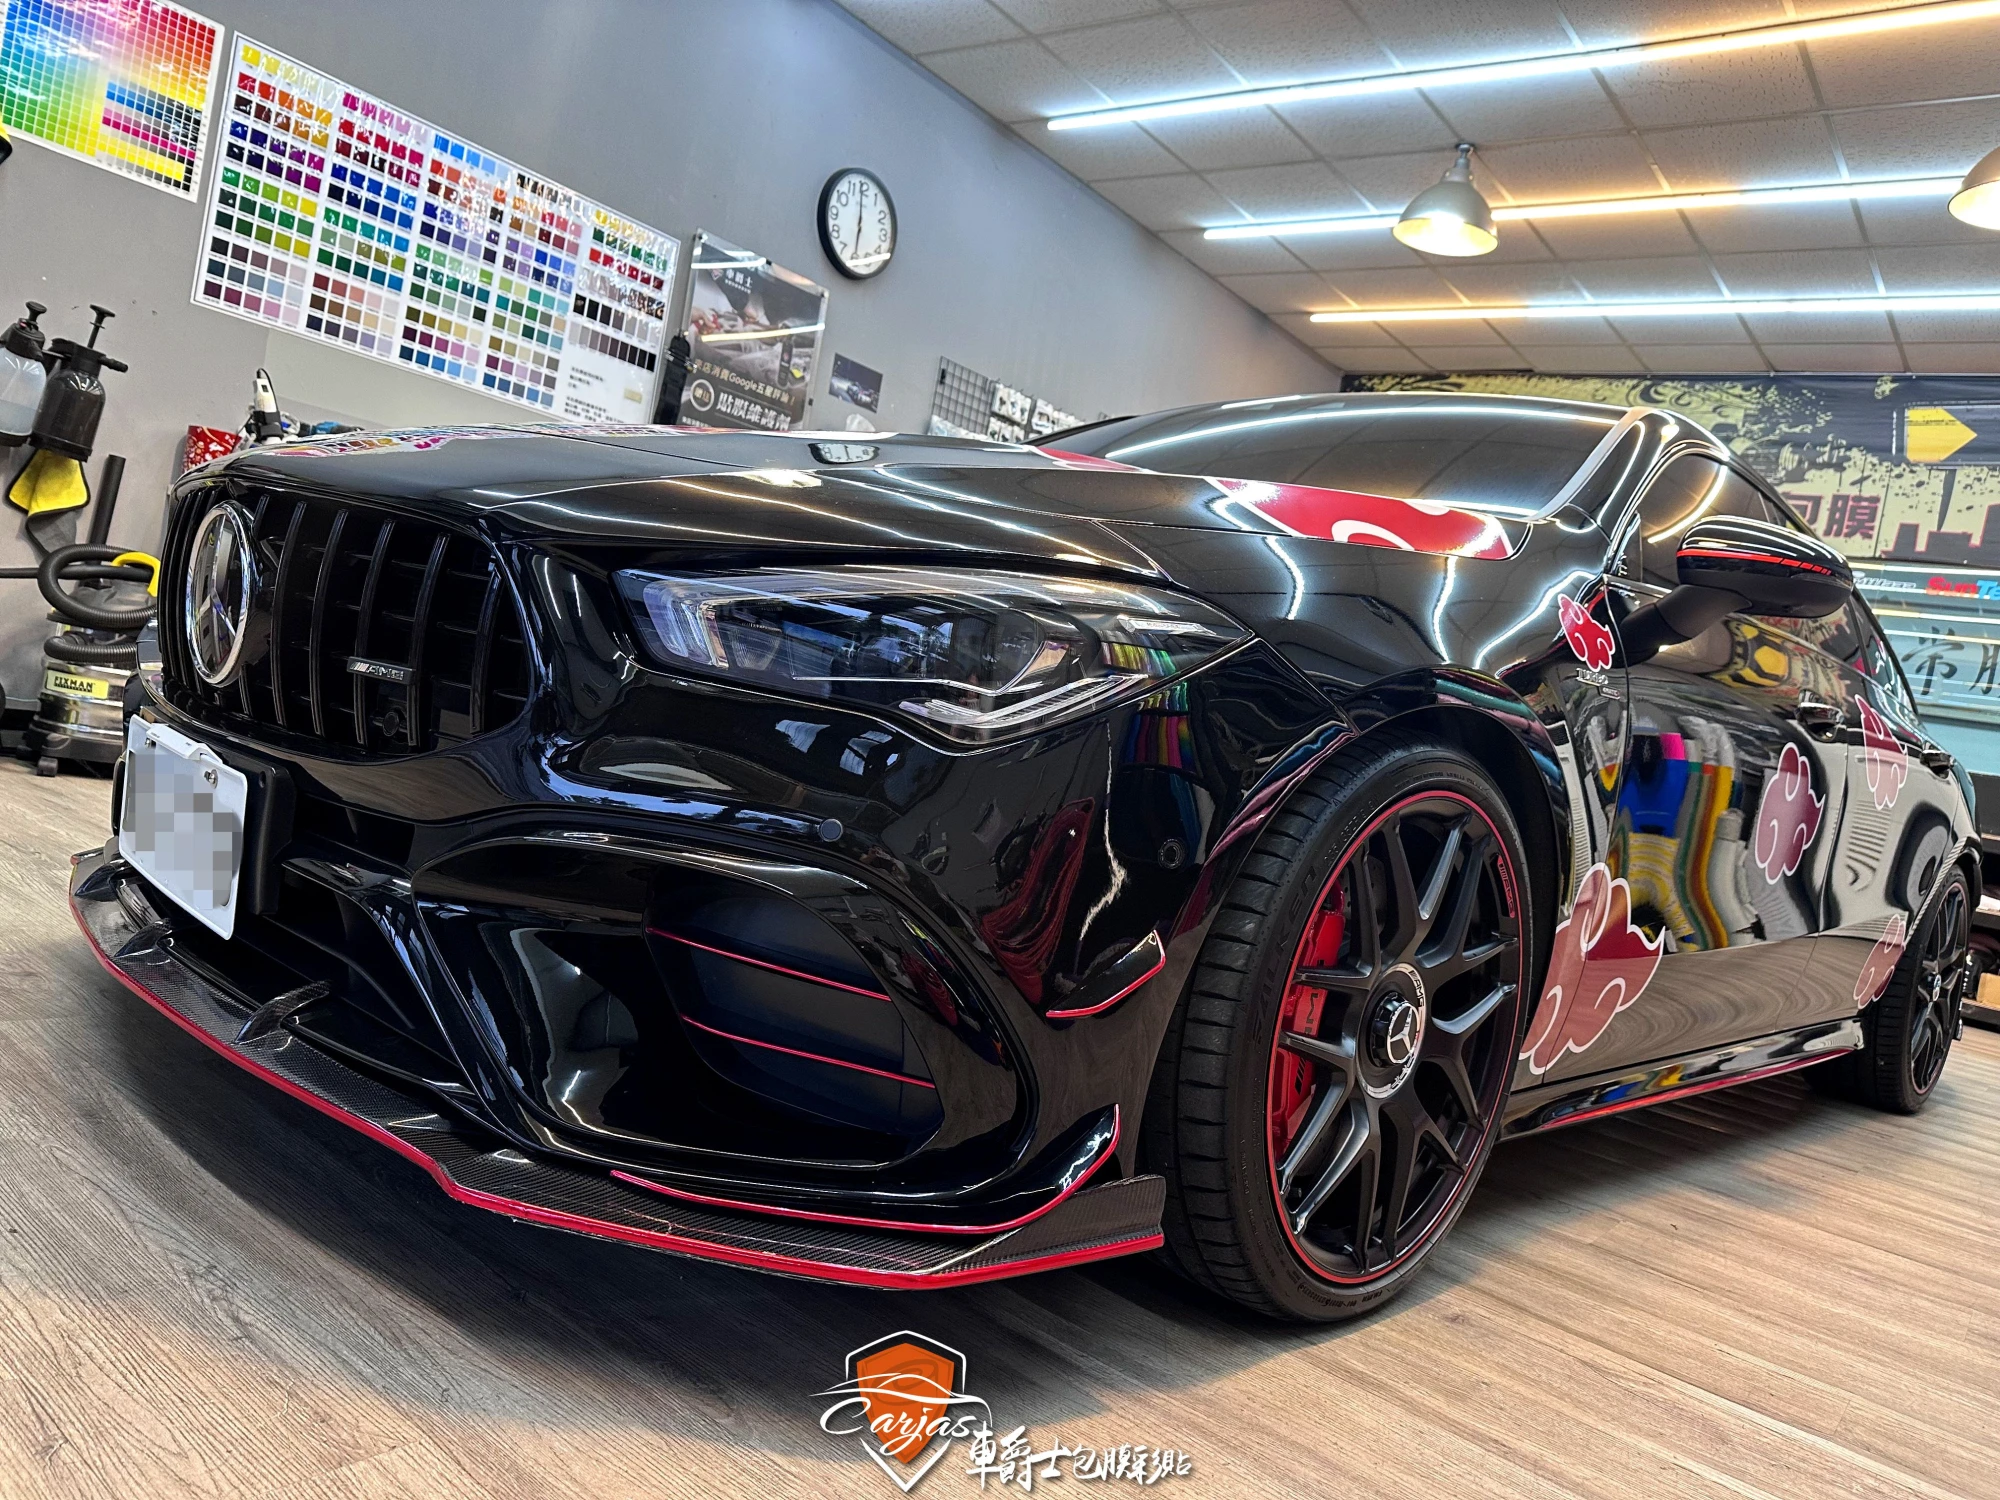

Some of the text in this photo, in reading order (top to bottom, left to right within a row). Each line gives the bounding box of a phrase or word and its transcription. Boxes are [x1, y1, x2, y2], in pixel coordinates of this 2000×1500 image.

[836, 190, 849, 207] 10
[830, 205, 839, 220] 9
[877, 210, 887, 225] 2
[831, 224, 840, 239] 8
[879, 228, 888, 242] 3
[840, 241, 848, 254] 7
[54, 675, 93, 690] FIXMAN
